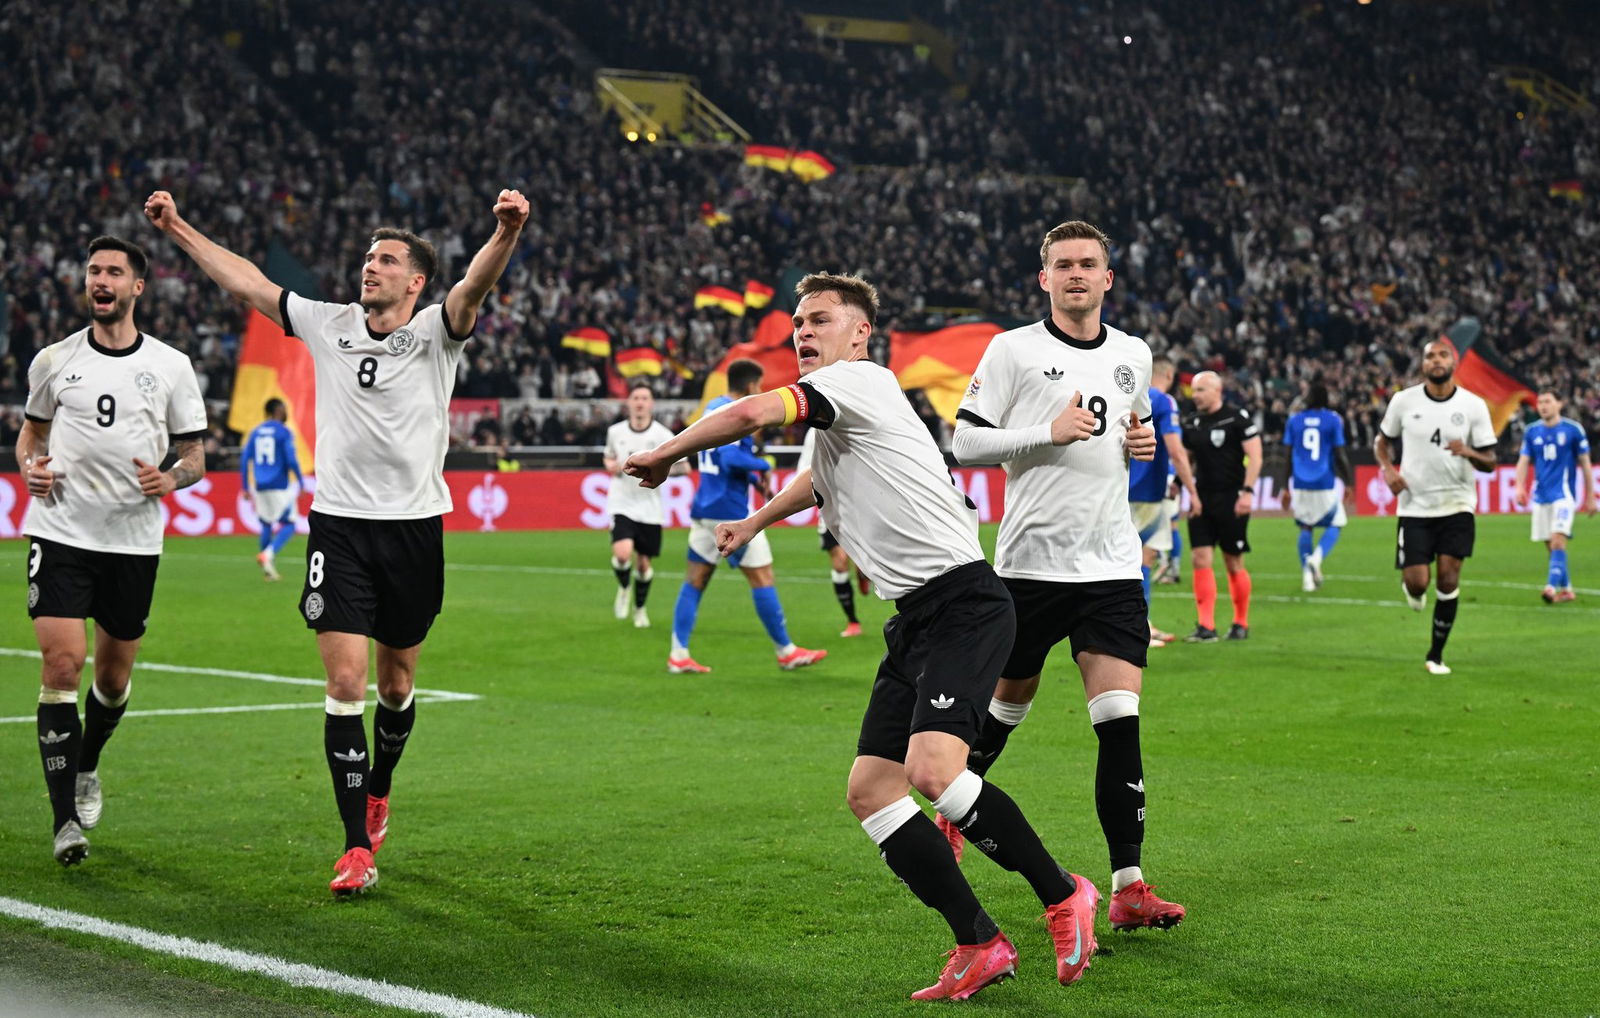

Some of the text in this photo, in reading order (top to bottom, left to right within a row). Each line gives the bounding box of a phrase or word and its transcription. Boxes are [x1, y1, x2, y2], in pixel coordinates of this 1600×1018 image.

[357, 357, 378, 388] 8
[96, 394, 116, 427] 9
[1302, 428, 1320, 461] 9
[1430, 428, 1441, 446] 4
[309, 550, 325, 589] 8
